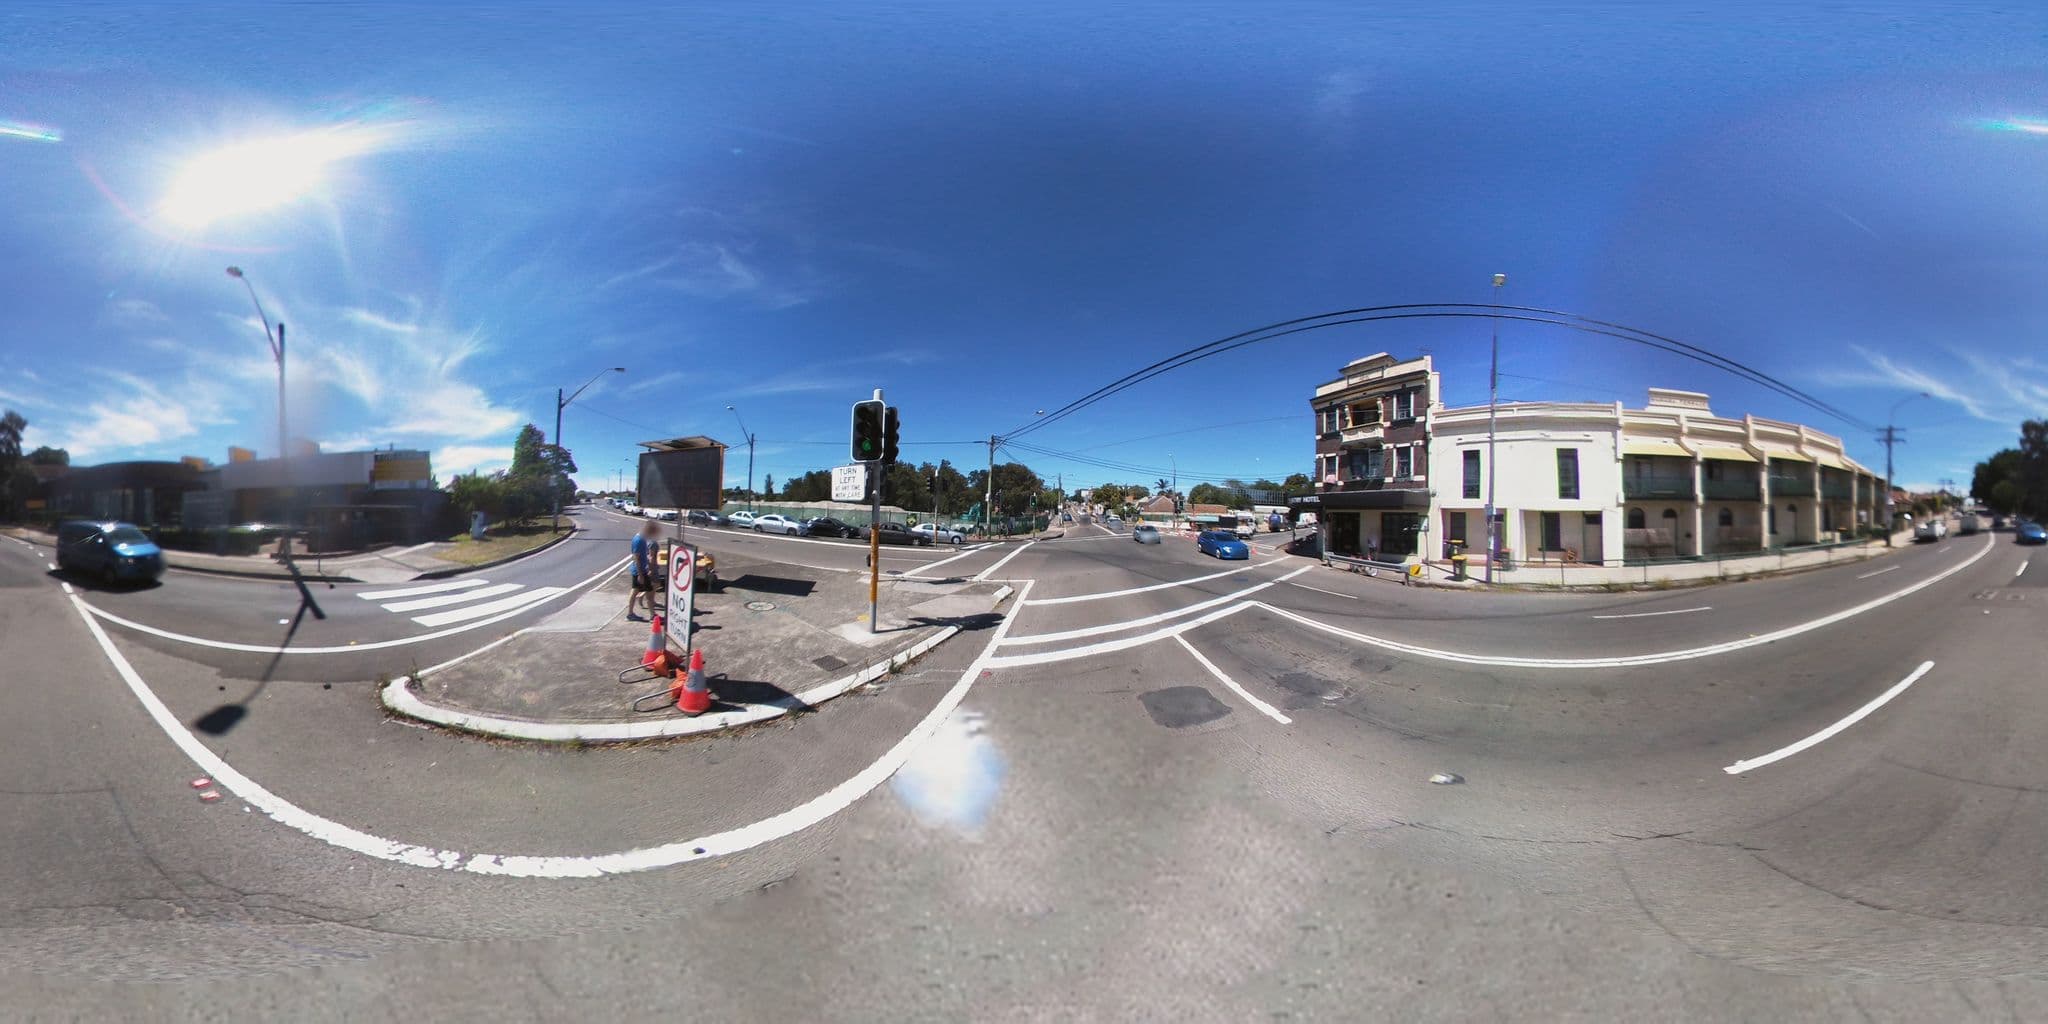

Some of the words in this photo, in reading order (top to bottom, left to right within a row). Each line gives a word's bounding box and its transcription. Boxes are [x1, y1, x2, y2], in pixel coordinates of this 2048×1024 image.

[839, 467, 857, 476] TURN
[839, 476, 855, 484] LEFT
[1302, 495, 1320, 503] HOTEL
[672, 592, 685, 612] NO
[669, 608, 688, 630] RIGHT
[670, 622, 686, 645] TURN
